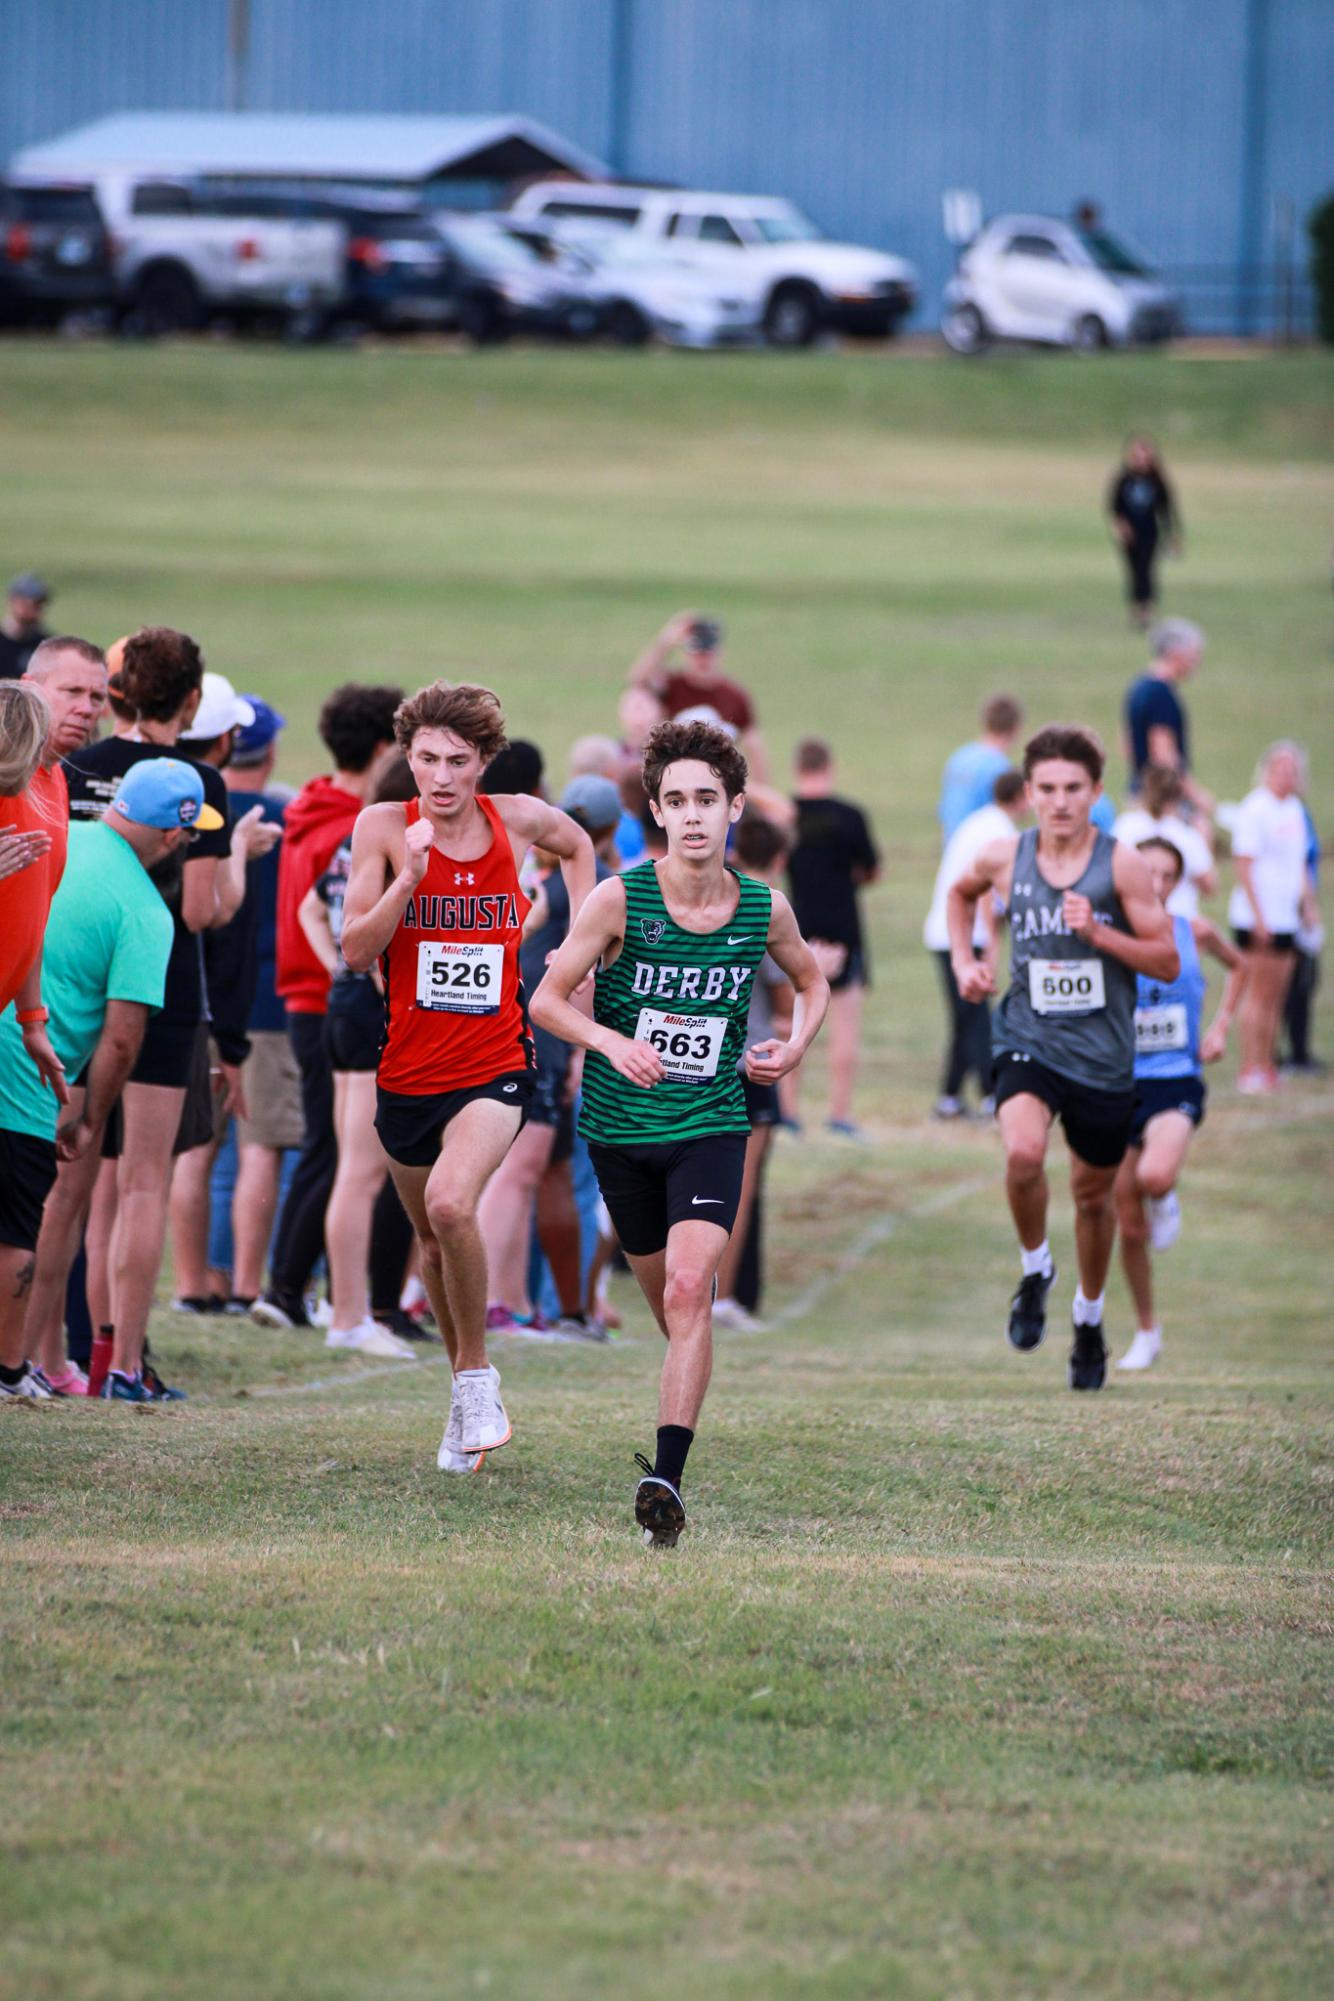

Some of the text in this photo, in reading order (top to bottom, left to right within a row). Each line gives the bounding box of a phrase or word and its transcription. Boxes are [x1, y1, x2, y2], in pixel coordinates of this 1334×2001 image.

[403, 893, 519, 930] AUGUSTA
[441, 945, 484, 958] MileSplit
[432, 961, 491, 988] 526
[631, 961, 751, 1001] DERBY
[431, 989, 487, 1001] Heartland Timing
[663, 1015, 708, 1029] MileSplit
[650, 1029, 712, 1059] 663
[682, 1062, 705, 1073] Timing
